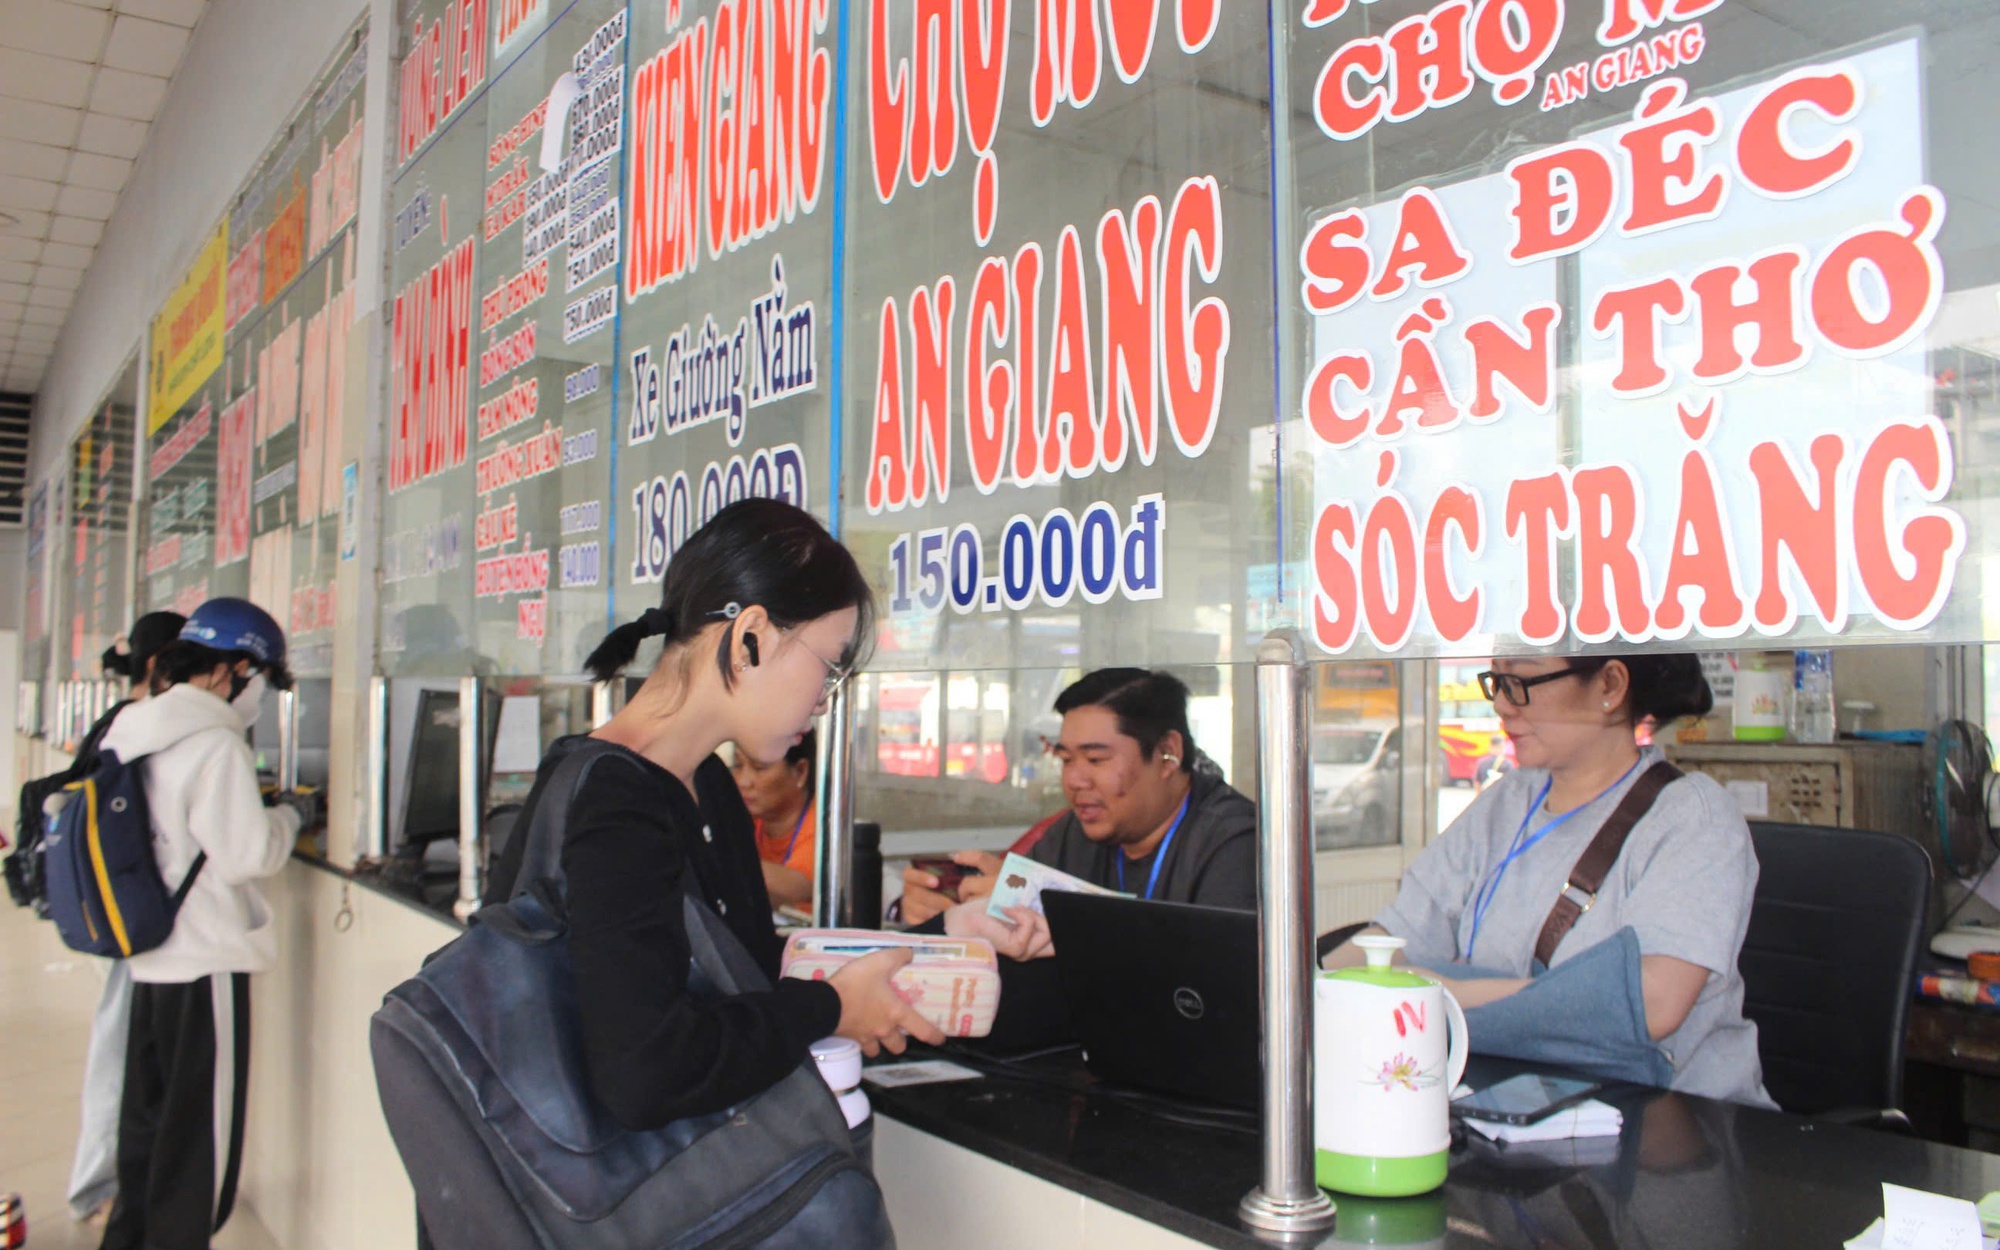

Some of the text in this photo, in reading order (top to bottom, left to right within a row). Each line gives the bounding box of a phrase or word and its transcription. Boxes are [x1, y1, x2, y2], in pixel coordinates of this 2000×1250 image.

[1541, 26, 1703, 109] AN GIANG
[1304, 71, 1858, 311] SA ĐÉC
[631, 256, 814, 443] Xe Giường Nằm
[867, 177, 1228, 512] AN GIANG
[1306, 193, 1935, 446] CẦN THƠ
[892, 498, 1161, 610] 150.000đ
[1311, 396, 1955, 649] SÓC TRĂNG
